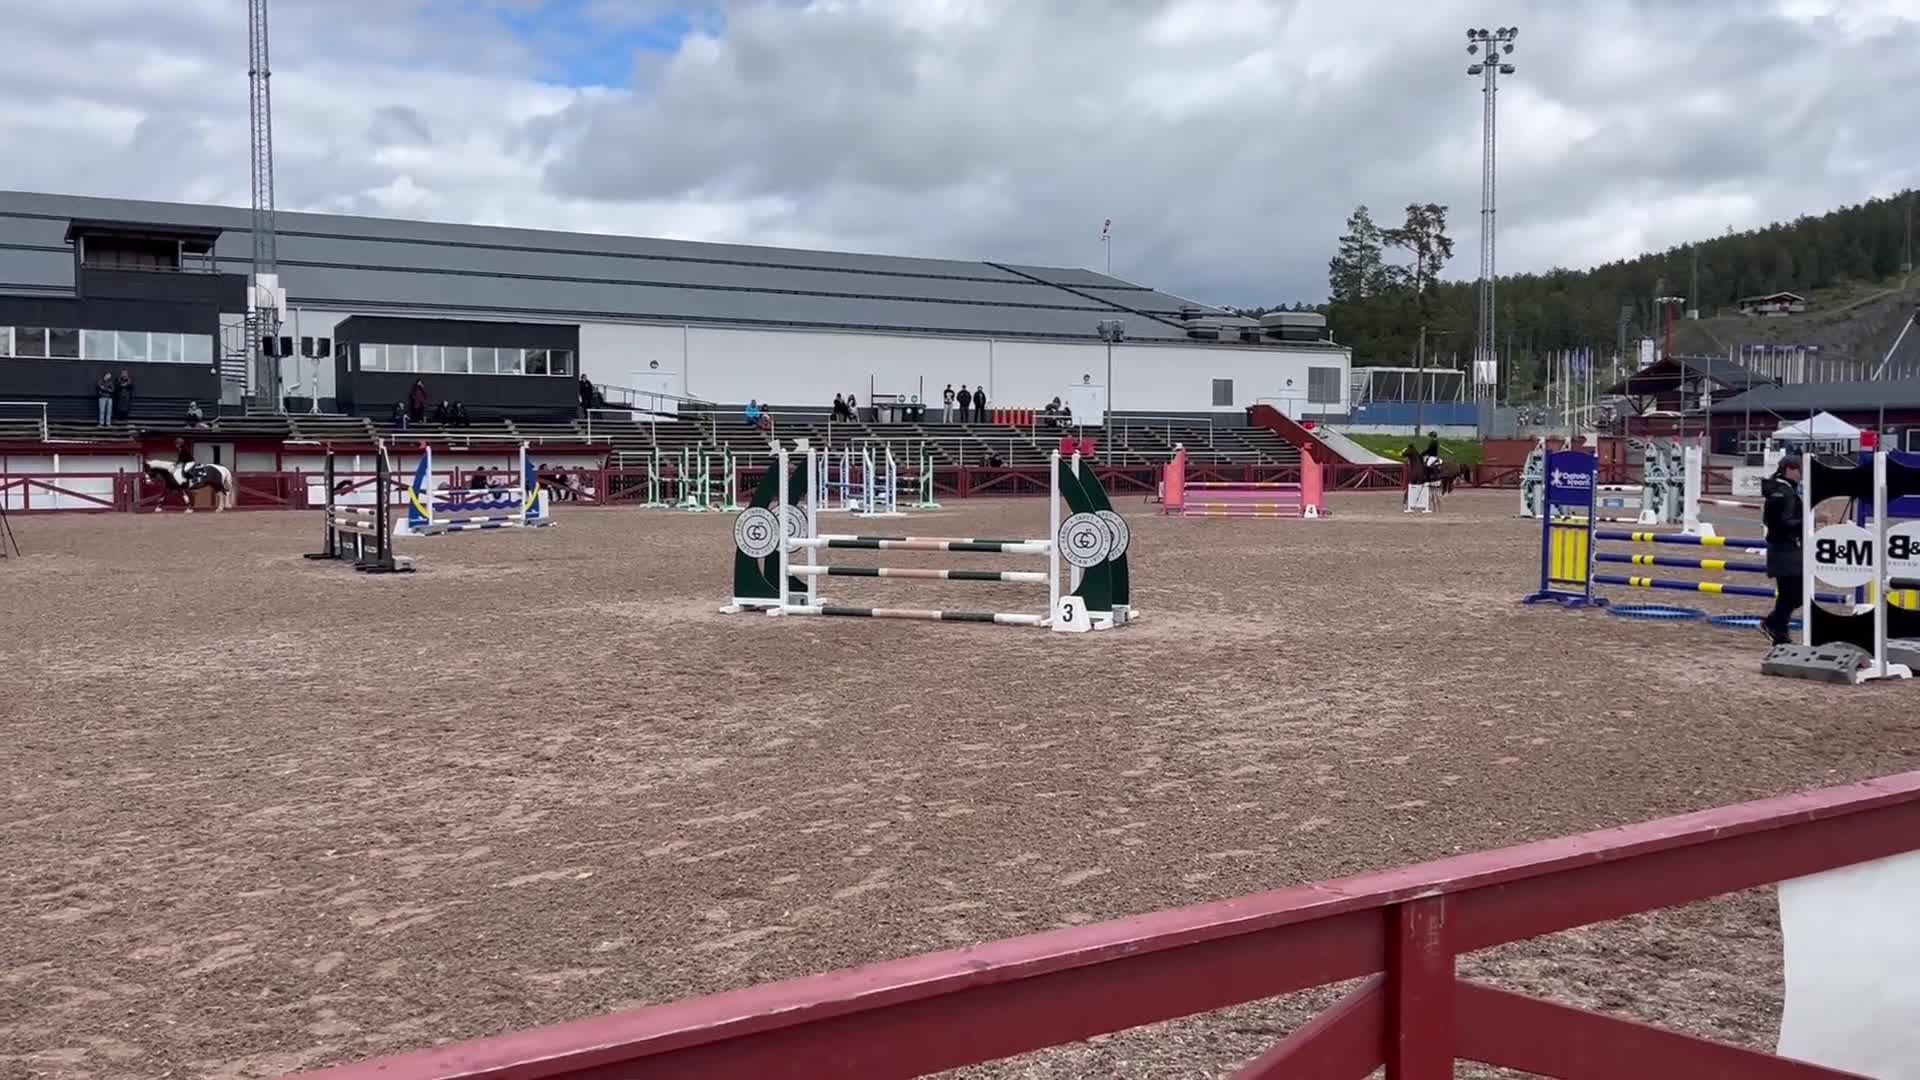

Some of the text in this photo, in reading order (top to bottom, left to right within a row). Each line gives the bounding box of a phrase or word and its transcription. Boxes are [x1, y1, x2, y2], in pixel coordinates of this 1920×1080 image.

[1815, 538, 1873, 567] B&M
[1888, 535, 1920, 560] B&
[1062, 603, 1074, 623] 3
